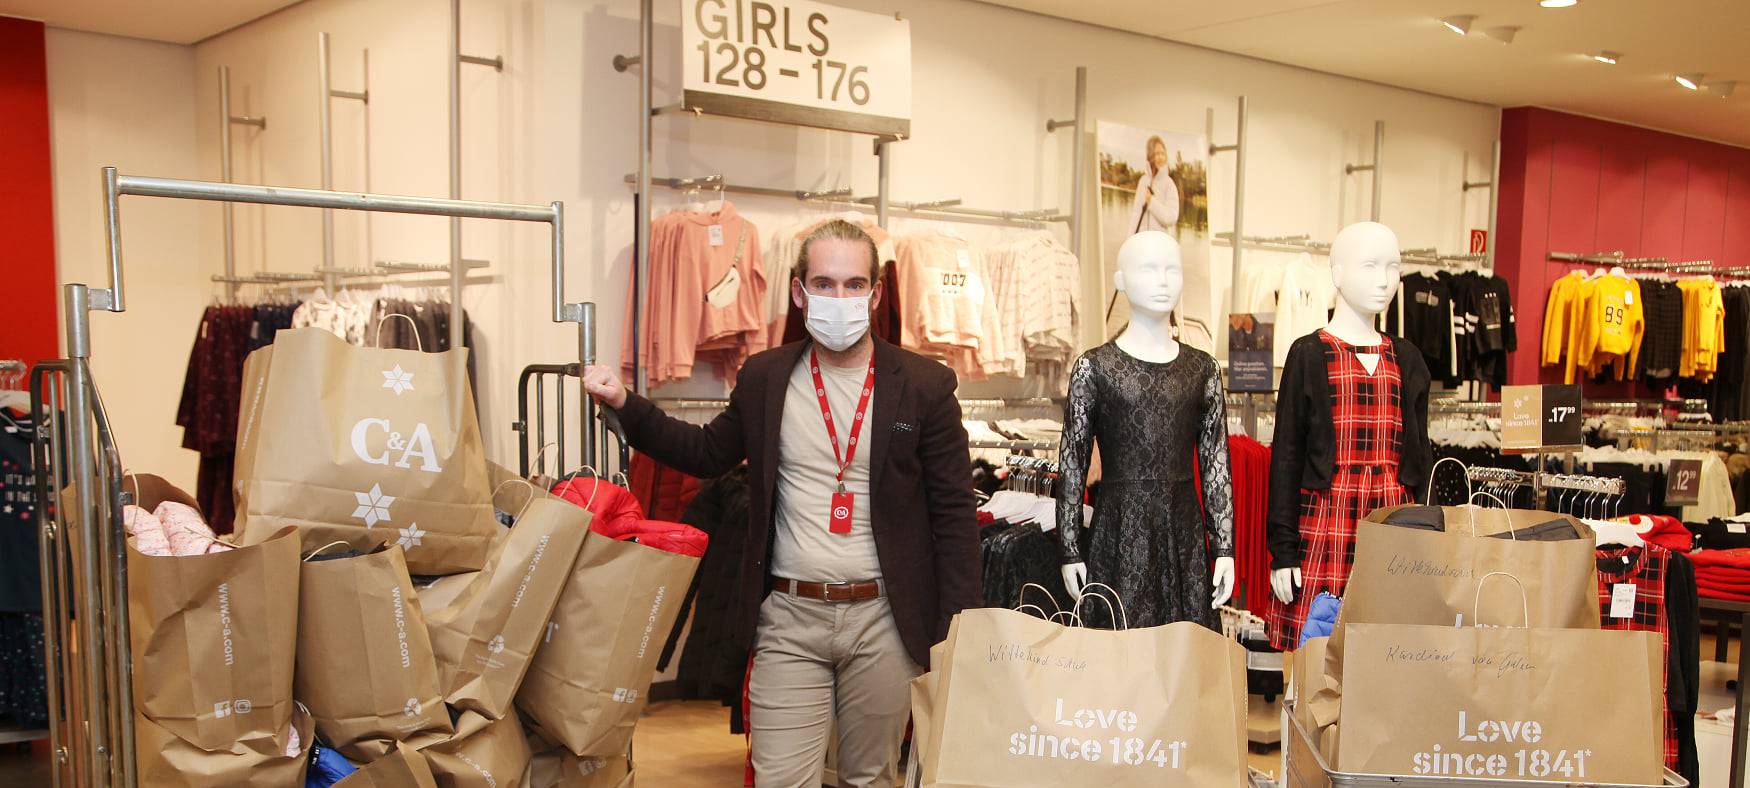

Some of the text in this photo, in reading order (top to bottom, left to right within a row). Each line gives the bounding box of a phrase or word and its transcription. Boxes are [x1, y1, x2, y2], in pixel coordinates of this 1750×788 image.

[695, 0, 829, 57] GIRLS
[697, 40, 767, 91] 128
[812, 59, 870, 105] 176
[351, 417, 442, 473] C&A
[512, 534, 550, 609] www.c-a.com
[218, 583, 234, 666] www.c-a.com
[391, 586, 410, 668] www.c-a.com
[637, 585, 666, 659] www.c-a.com
[1008, 724, 1102, 762] since
[1056, 698, 1138, 732] Love
[1458, 710, 1542, 743] Love
[1412, 743, 1508, 776] since
